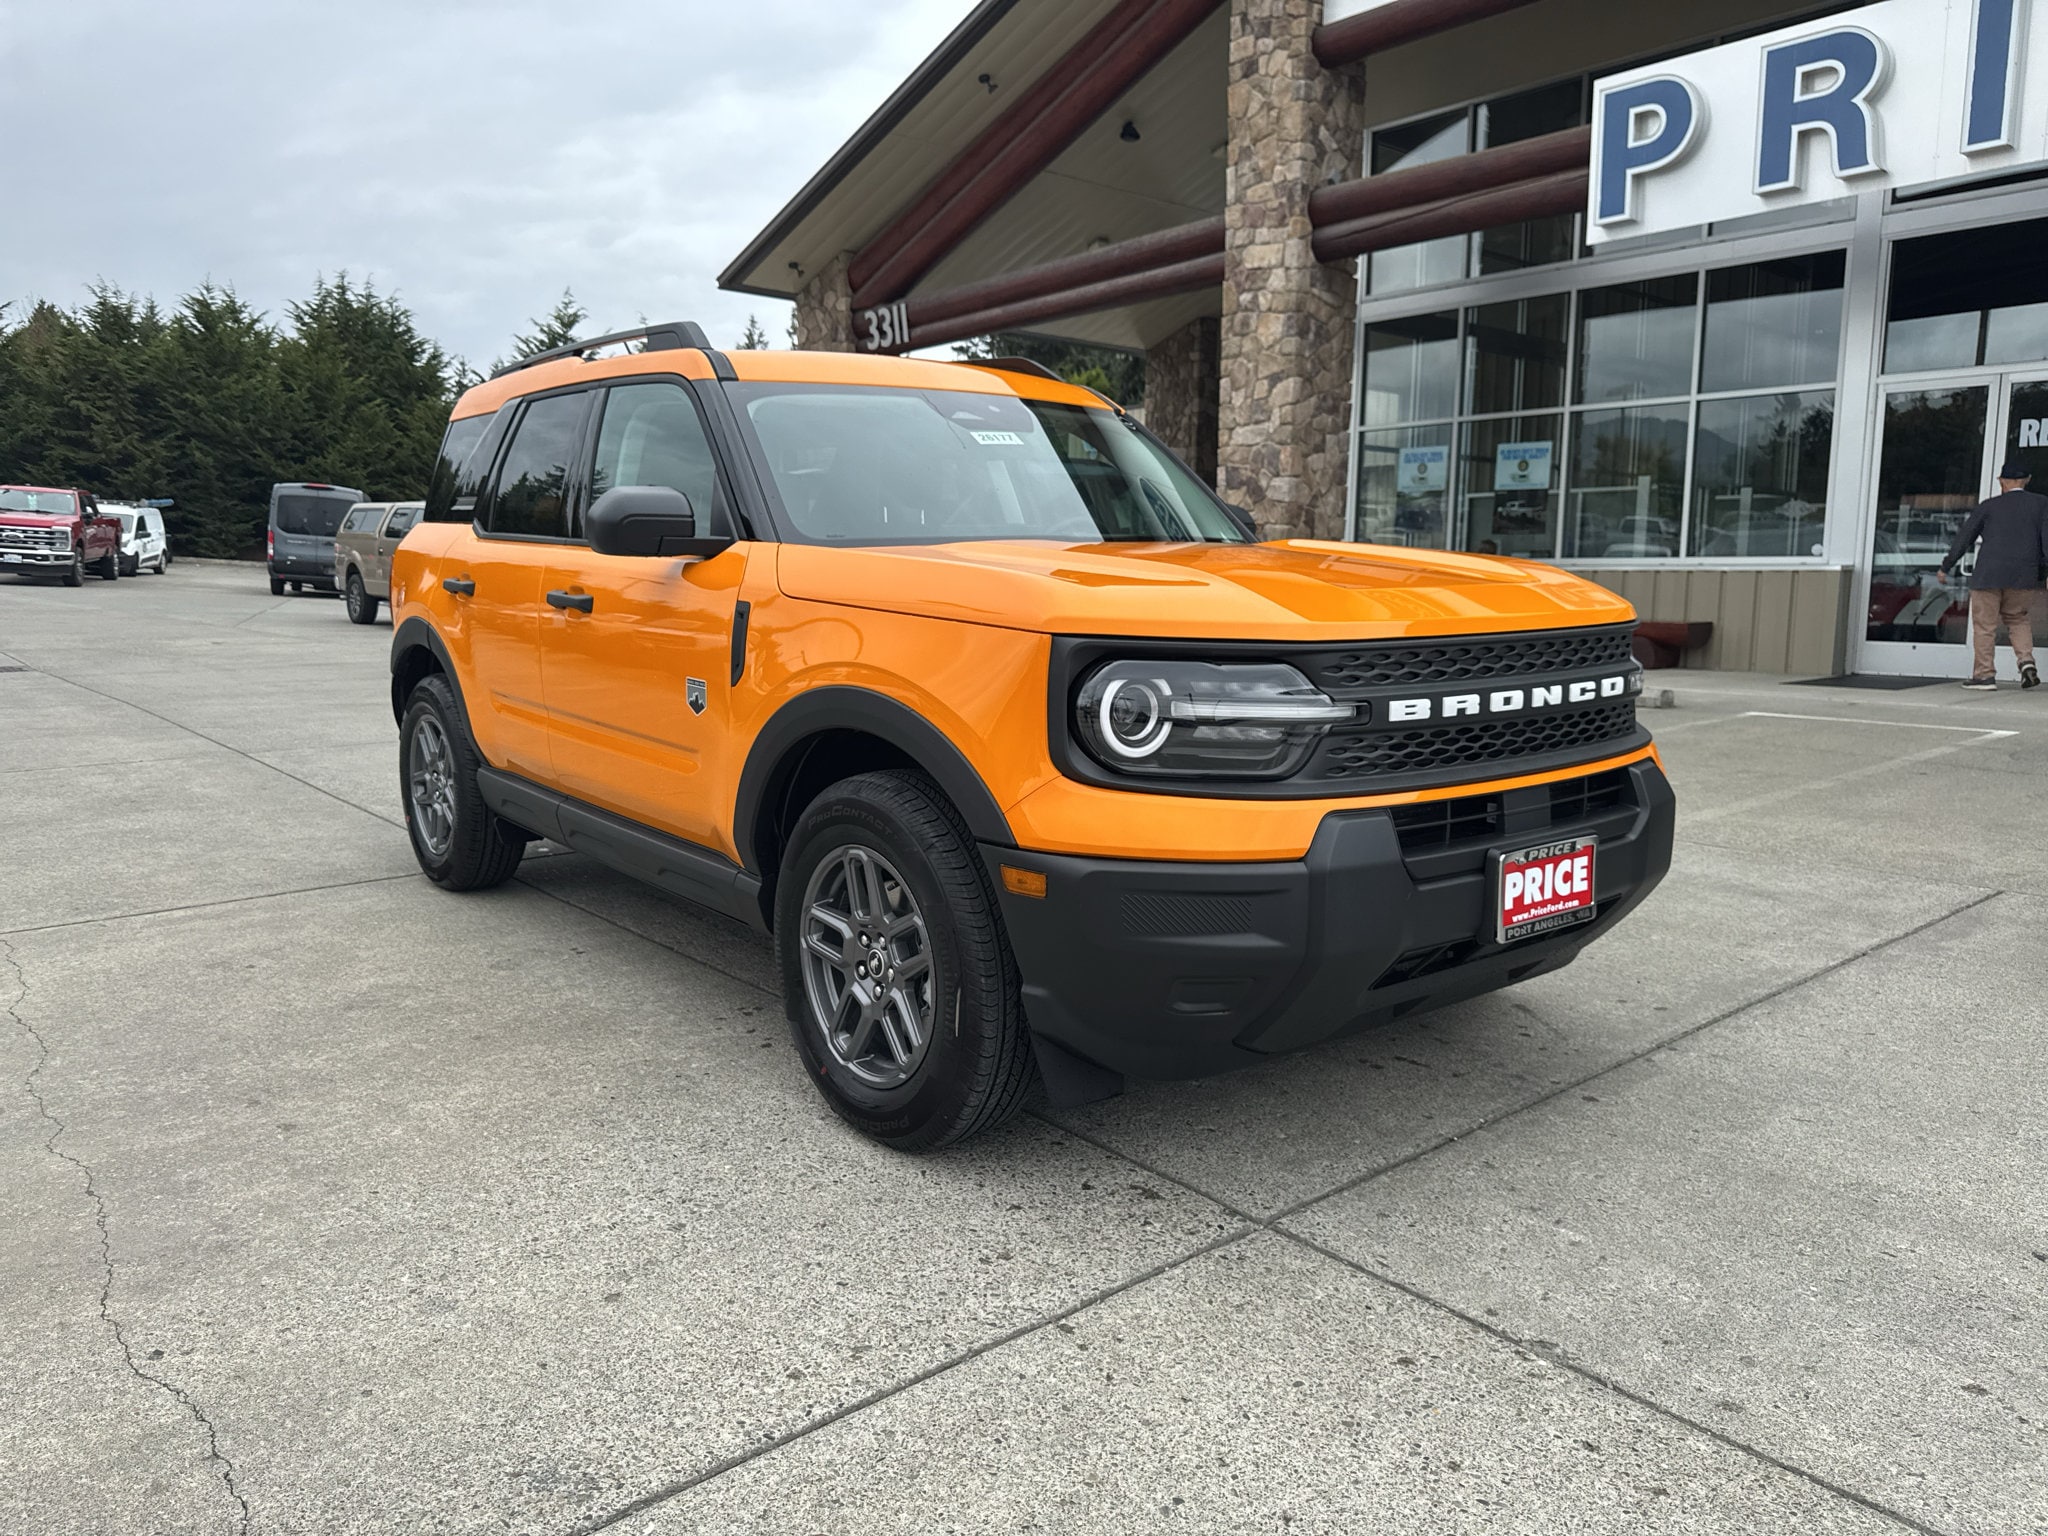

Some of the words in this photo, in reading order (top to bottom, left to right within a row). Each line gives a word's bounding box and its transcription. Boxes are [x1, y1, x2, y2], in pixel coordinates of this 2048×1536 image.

[1594, 0, 2016, 226] PRI
[864, 303, 910, 350] 3311
[978, 433, 1013, 442] 26177
[1388, 676, 1625, 722] BRONCO
[1528, 843, 1571, 861] PRICE
[1504, 856, 1588, 910] PRICE
[1512, 899, 1580, 922] www.PriceFord.com
[1507, 923, 1533, 939] PORT
